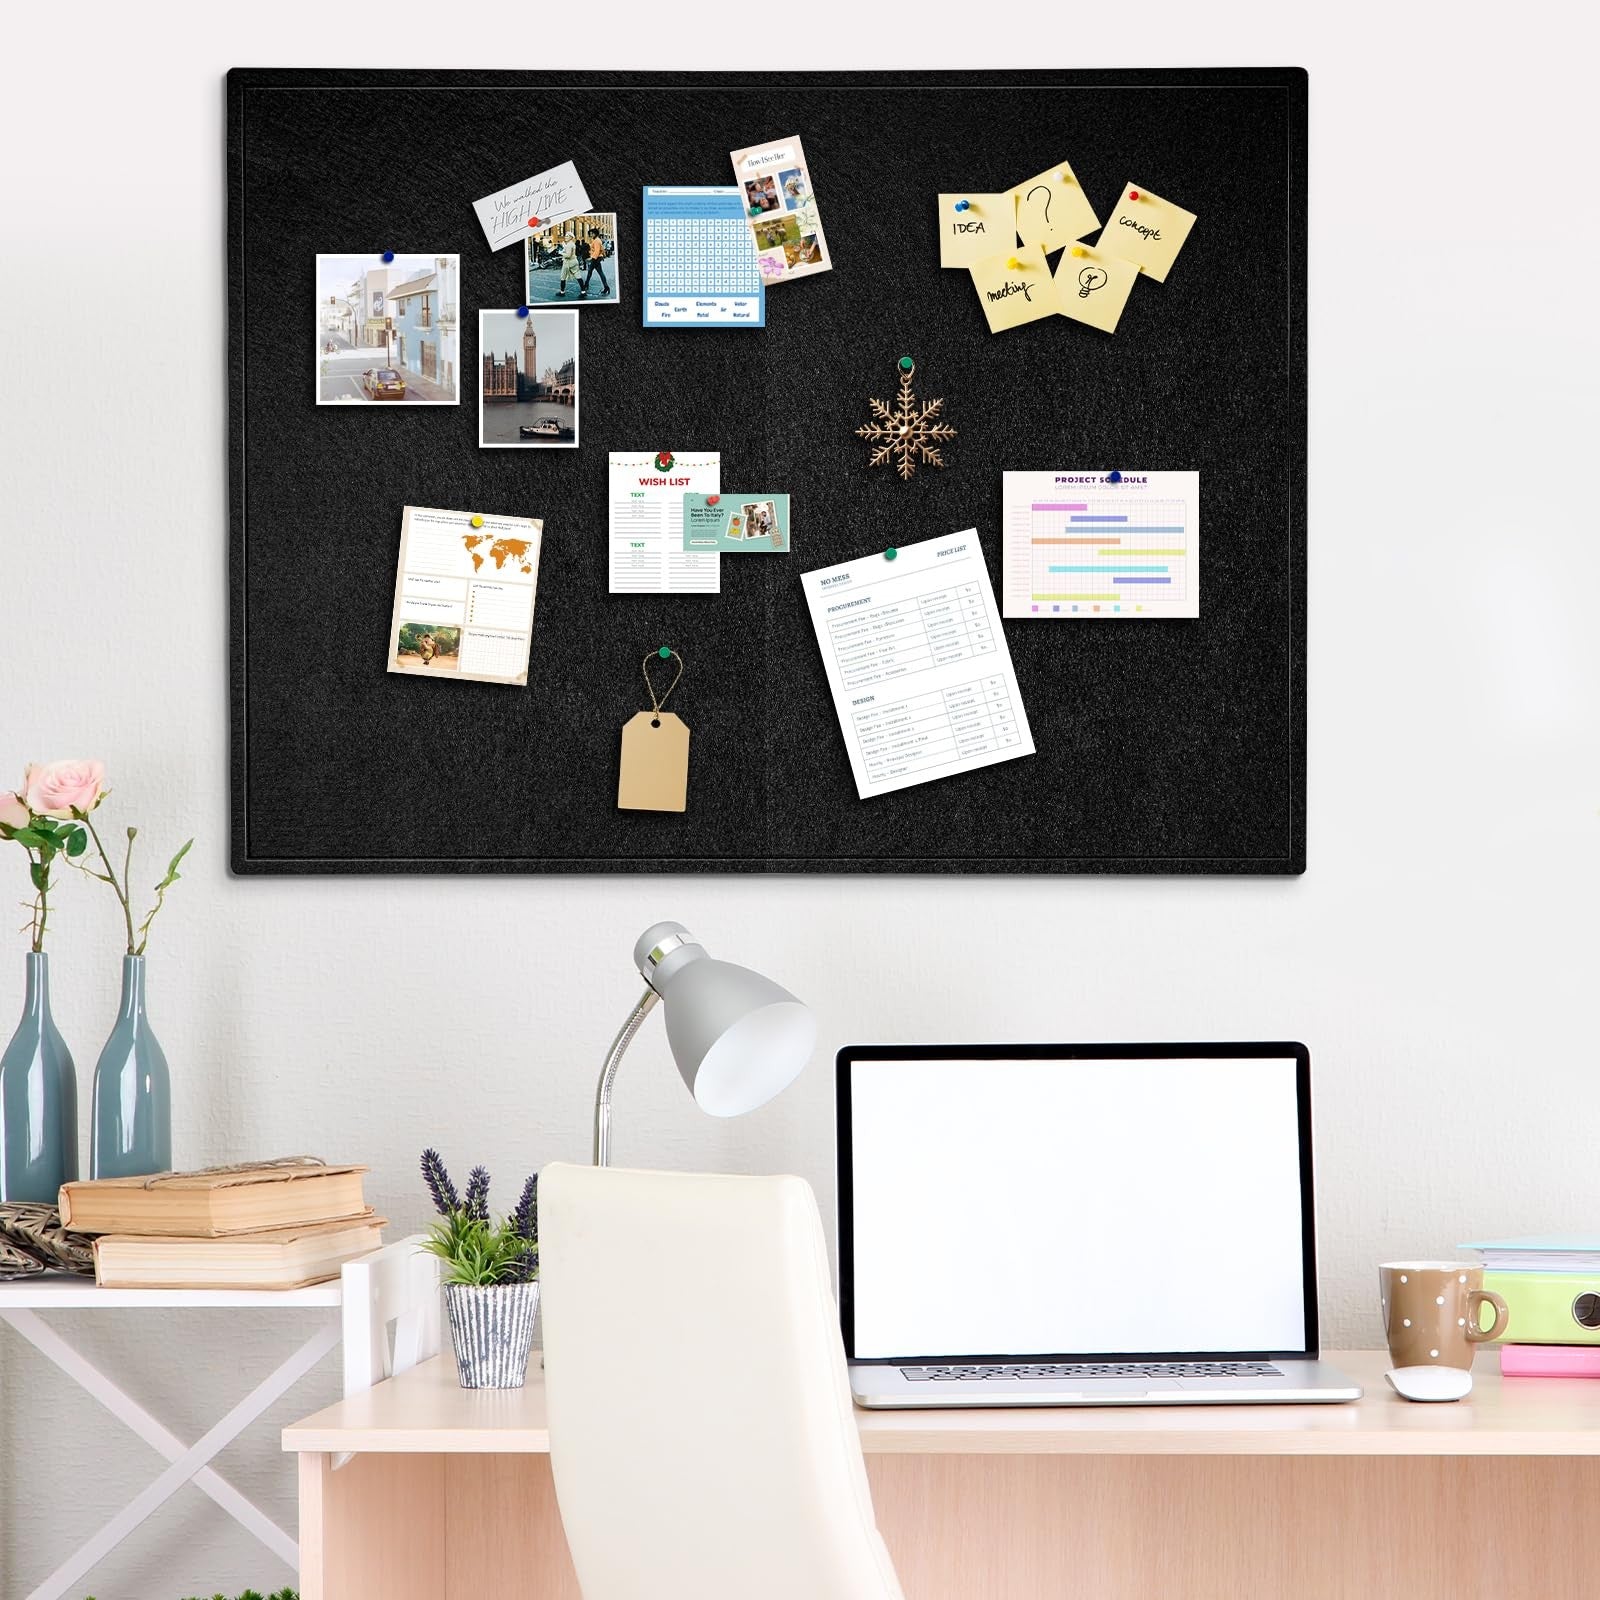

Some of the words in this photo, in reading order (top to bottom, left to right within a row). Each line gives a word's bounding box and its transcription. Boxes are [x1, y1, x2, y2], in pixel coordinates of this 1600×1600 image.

[953, 222, 985, 235] IDEA
[1119, 216, 1162, 241] concept
[987, 282, 1036, 302] meeting
[936, 548, 953, 557] PRICE
[953, 545, 967, 553] LIST
[831, 573, 850, 582] MESS
[827, 597, 872, 613] PROCUREMENT
[852, 695, 875, 705] DESIGN
